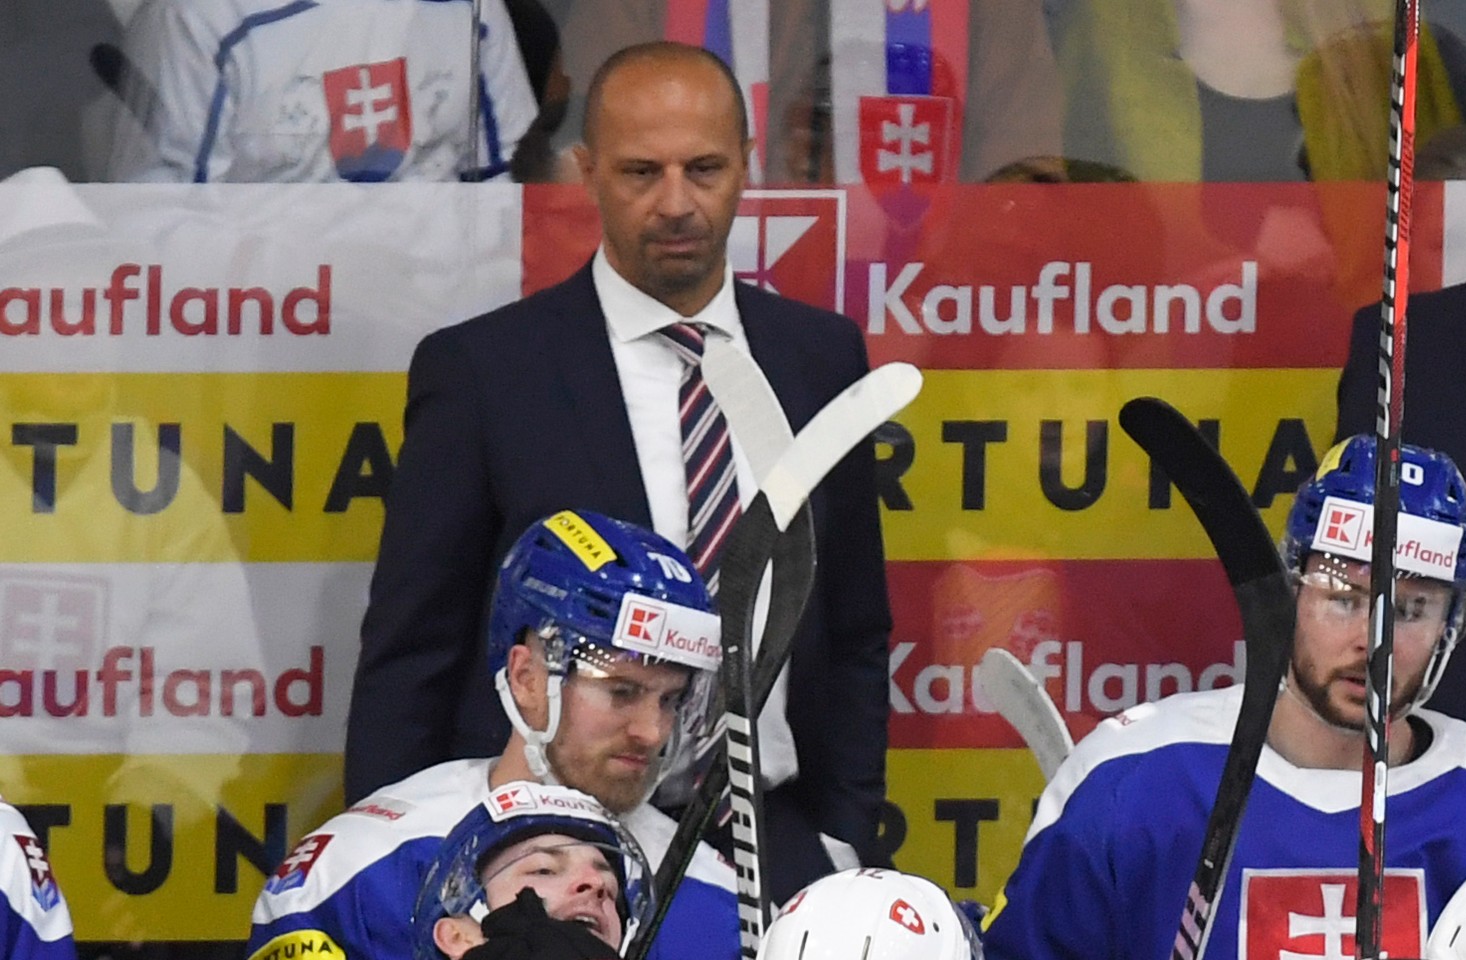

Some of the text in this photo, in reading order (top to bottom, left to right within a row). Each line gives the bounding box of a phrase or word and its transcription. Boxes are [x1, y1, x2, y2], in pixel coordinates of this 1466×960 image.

[0, 264, 332, 336] aufland
[867, 261, 1257, 336] Kaufland
[12, 422, 397, 515] TUNA
[1401, 462, 1425, 487] 0
[553, 515, 603, 560] FORTUNA
[665, 627, 723, 659] Kauflan
[0, 646, 325, 718] aufland
